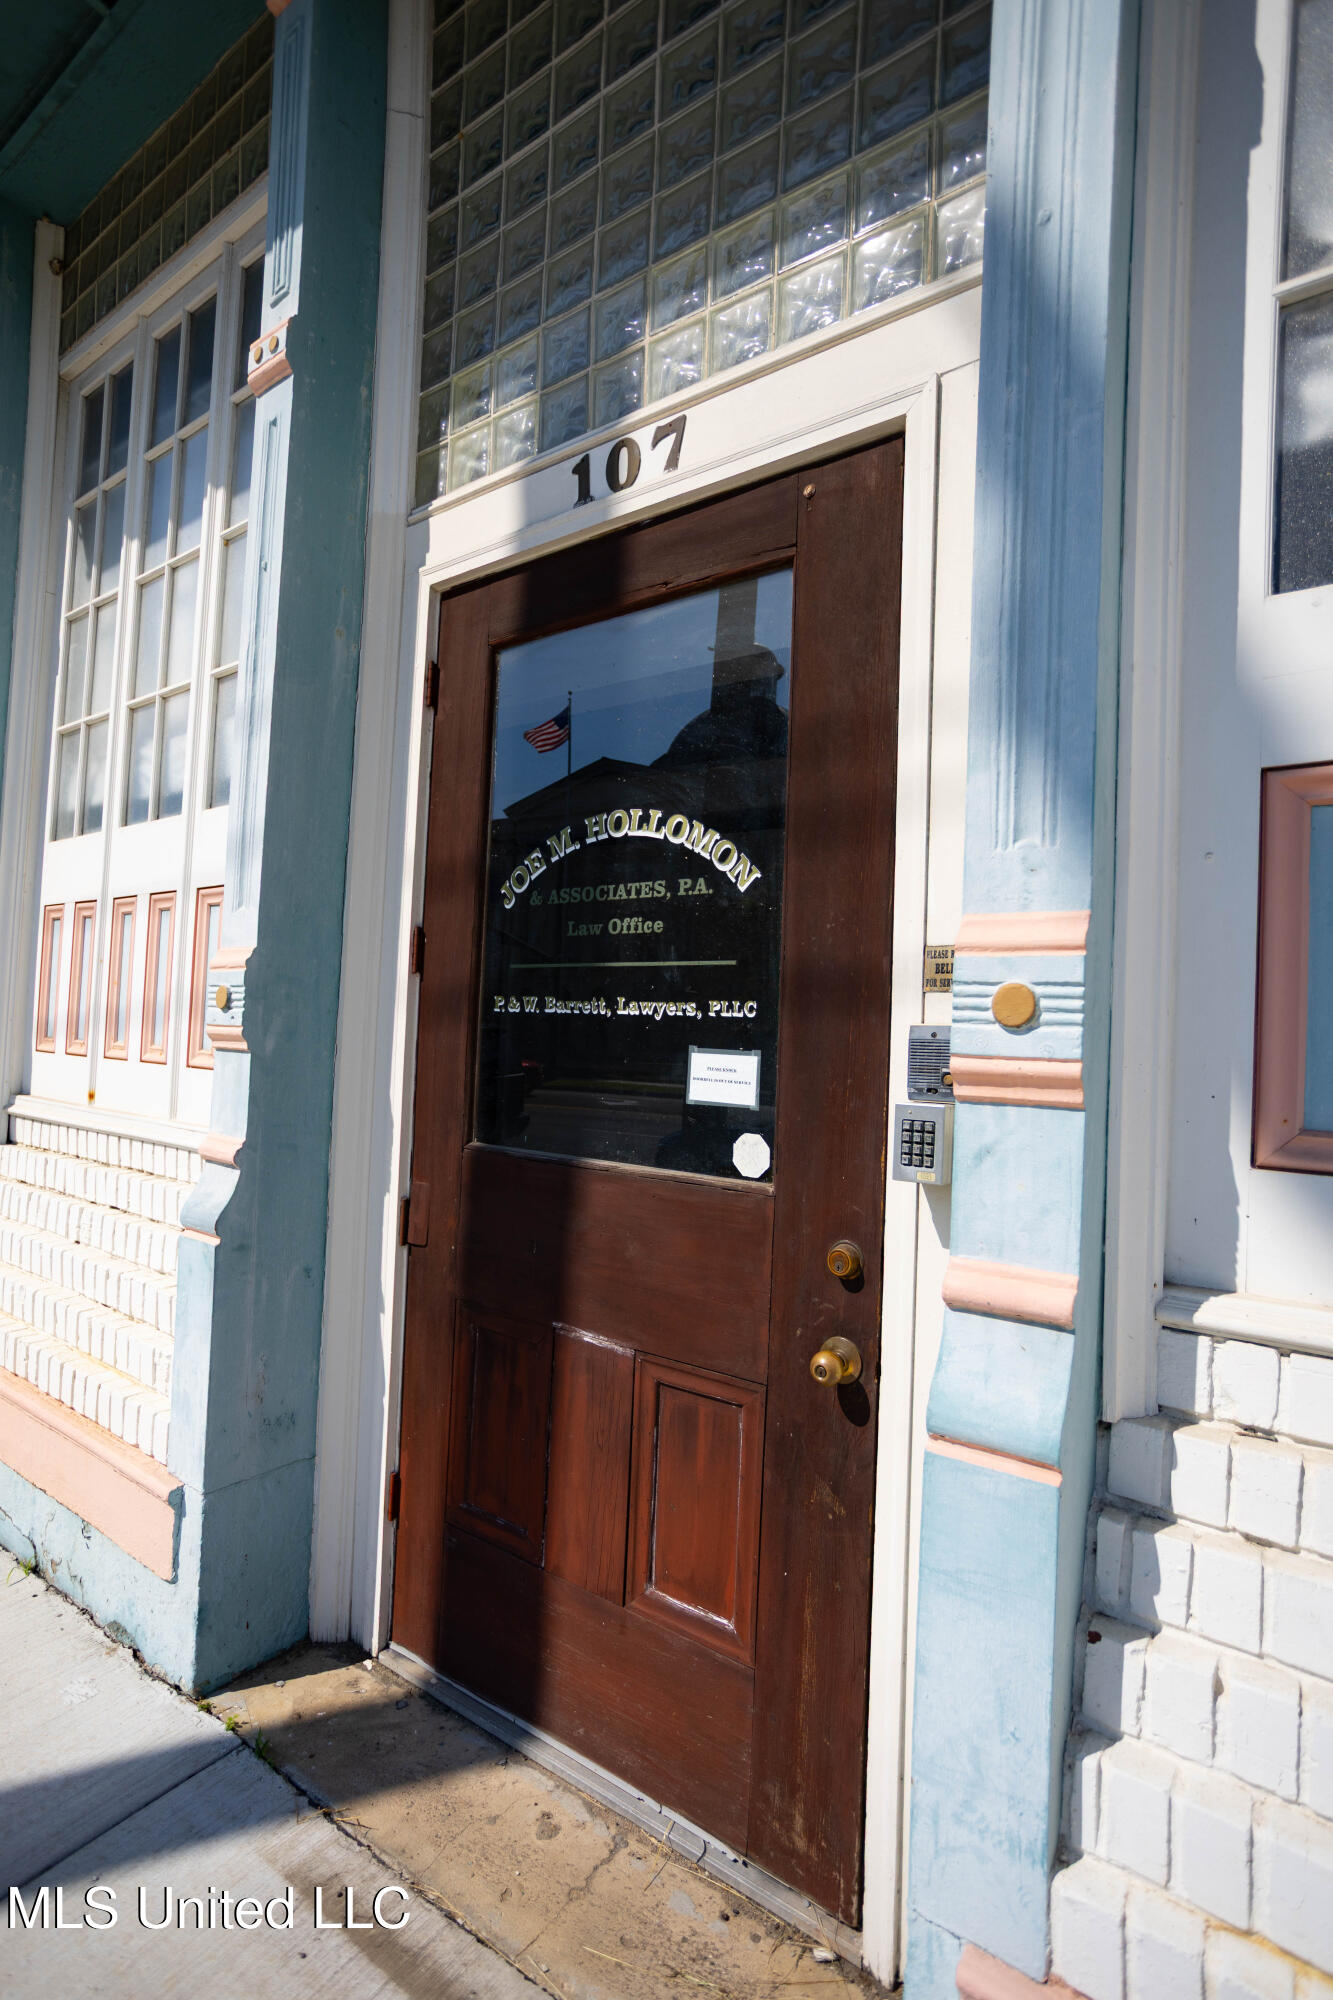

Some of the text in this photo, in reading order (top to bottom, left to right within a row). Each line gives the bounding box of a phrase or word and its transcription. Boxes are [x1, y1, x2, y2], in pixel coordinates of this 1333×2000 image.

[572, 414, 687, 508] 107
[500, 809, 762, 909] JOE M. HOLLOMON
[529, 877, 714, 906] & ASSOCIATES, P.A.
[567, 917, 664, 936] Law Office
[926, 949, 949, 959] PLEASE
[925, 978, 938, 988] FOR
[494, 995, 757, 1021] P. & W. Barrett, Lawyers, PLLC
